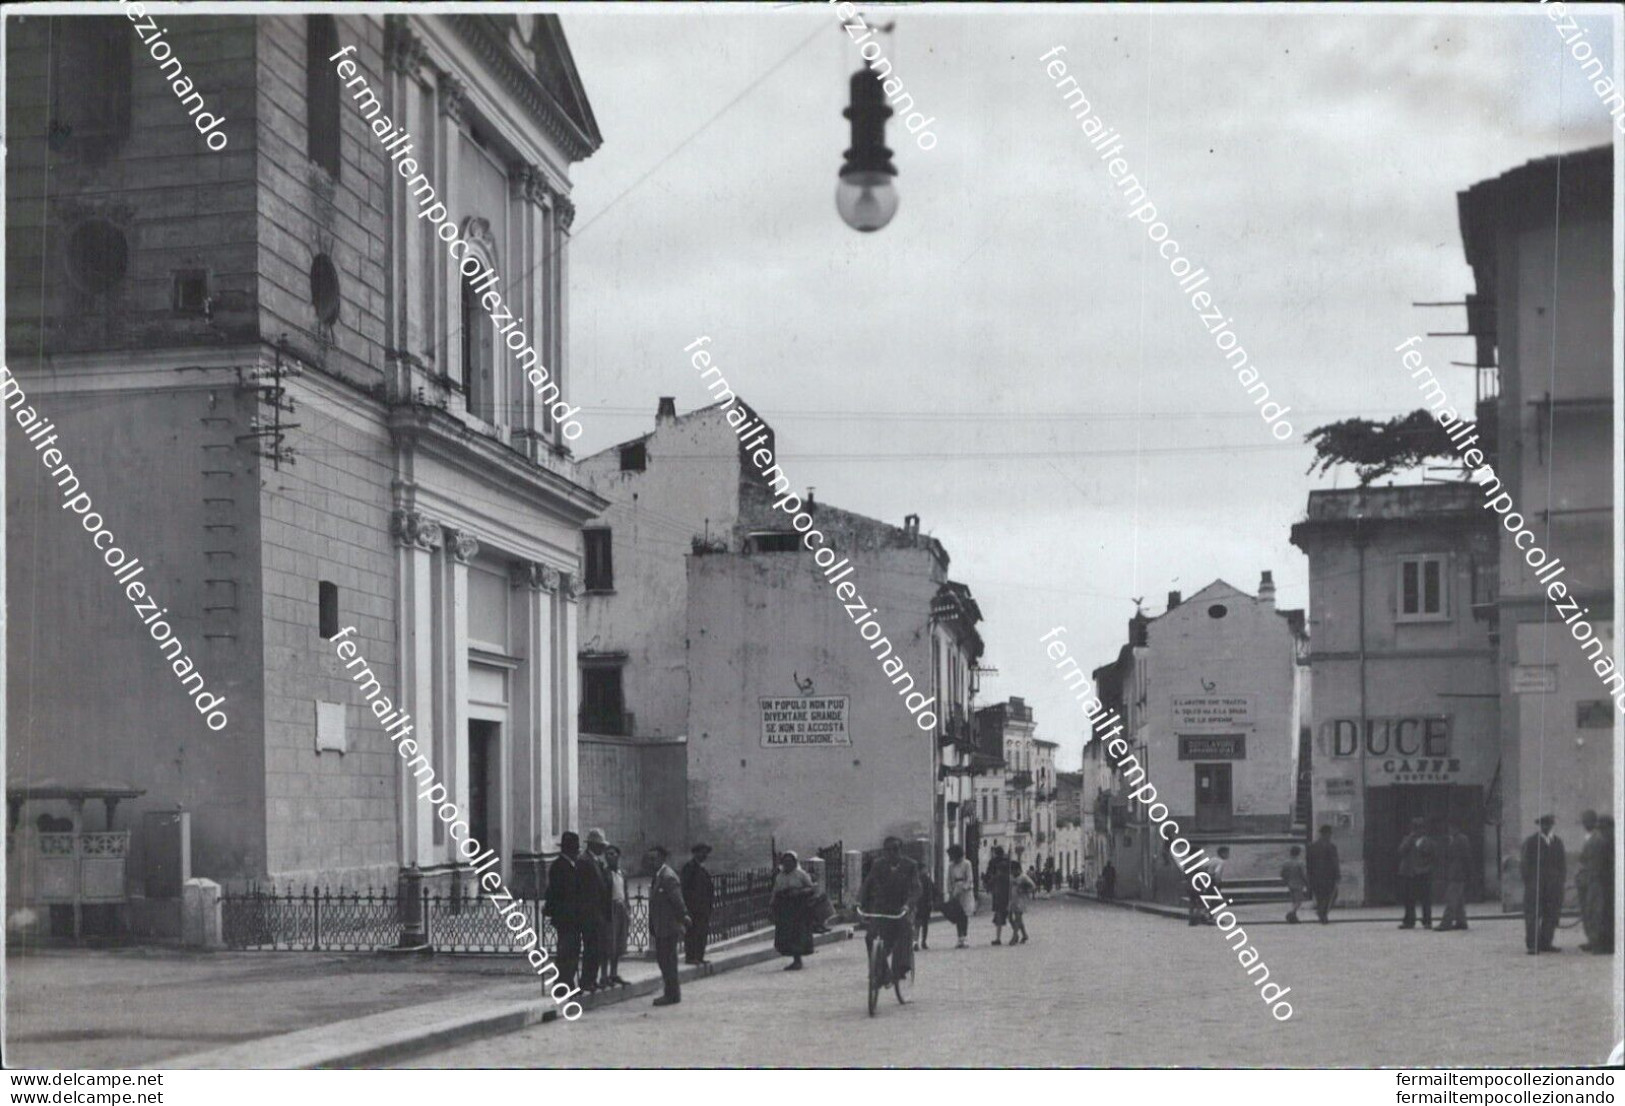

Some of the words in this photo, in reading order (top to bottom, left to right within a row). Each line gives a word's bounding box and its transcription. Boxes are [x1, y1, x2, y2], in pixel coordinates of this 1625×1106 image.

[761, 700, 773, 710] UN
[809, 700, 826, 709] NON
[764, 711, 807, 721] DIVENTARE
[811, 711, 842, 721] GRANDE
[766, 723, 776, 733] SE
[778, 723, 795, 733] NON
[797, 723, 805, 733] SI
[807, 722, 844, 732] ACCOSTA
[767, 734, 788, 744] ALLA
[791, 733, 833, 743] RELIGIONE
[1334, 718, 1448, 757] DUCE
